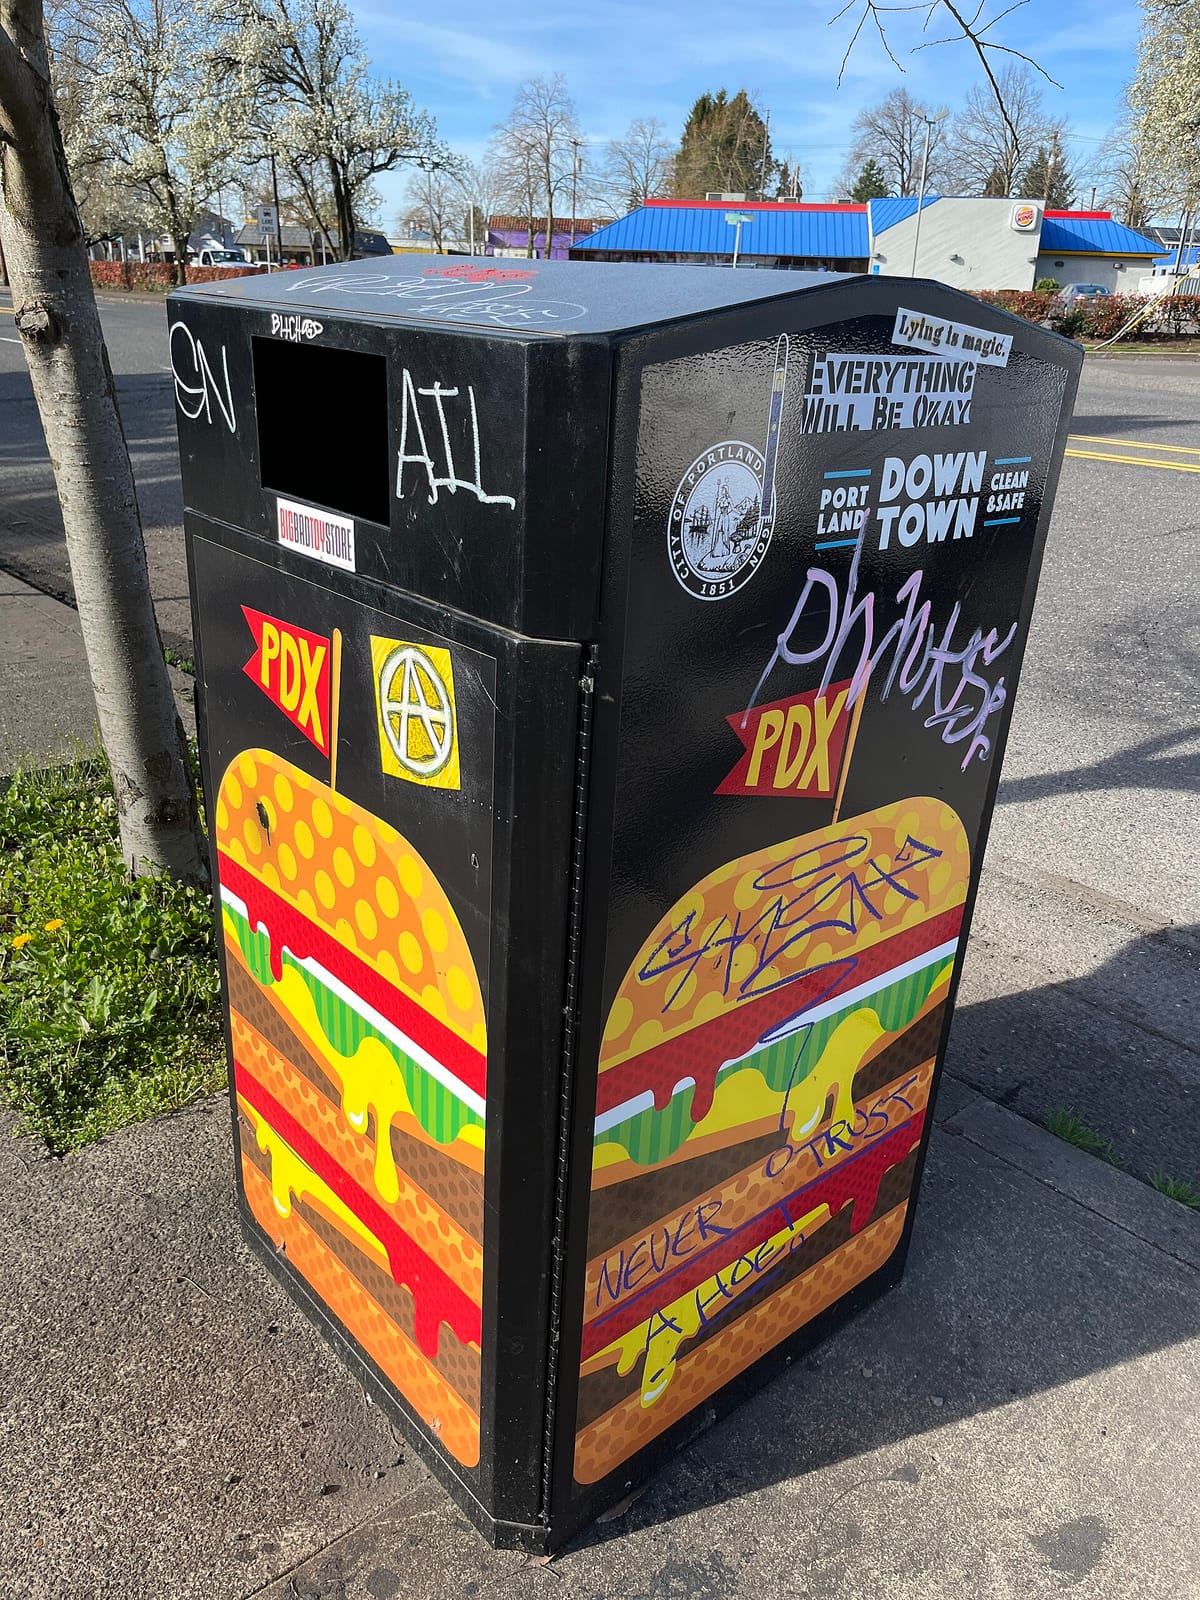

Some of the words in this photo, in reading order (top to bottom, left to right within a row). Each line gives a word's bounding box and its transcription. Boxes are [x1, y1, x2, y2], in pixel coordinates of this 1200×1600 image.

[898, 314, 945, 347] Lying
[947, 324, 960, 347] is
[962, 333, 1006, 358] magic.
[804, 352, 975, 395] EVERYTHING
[819, 485, 870, 510] PORT
[879, 451, 987, 502] DOWN
[990, 470, 1029, 491] CLEAN
[673, 494, 686, 520] OF
[816, 509, 867, 534] LAND
[876, 498, 979, 550] TOWN
[986, 492, 1025, 513] &SAFE
[671, 536, 689, 579] CITY
[700, 579, 735, 596] 1851
[261, 621, 327, 748] PDX
[745, 688, 850, 791] PDX
[596, 1201, 733, 1308] NEVER
